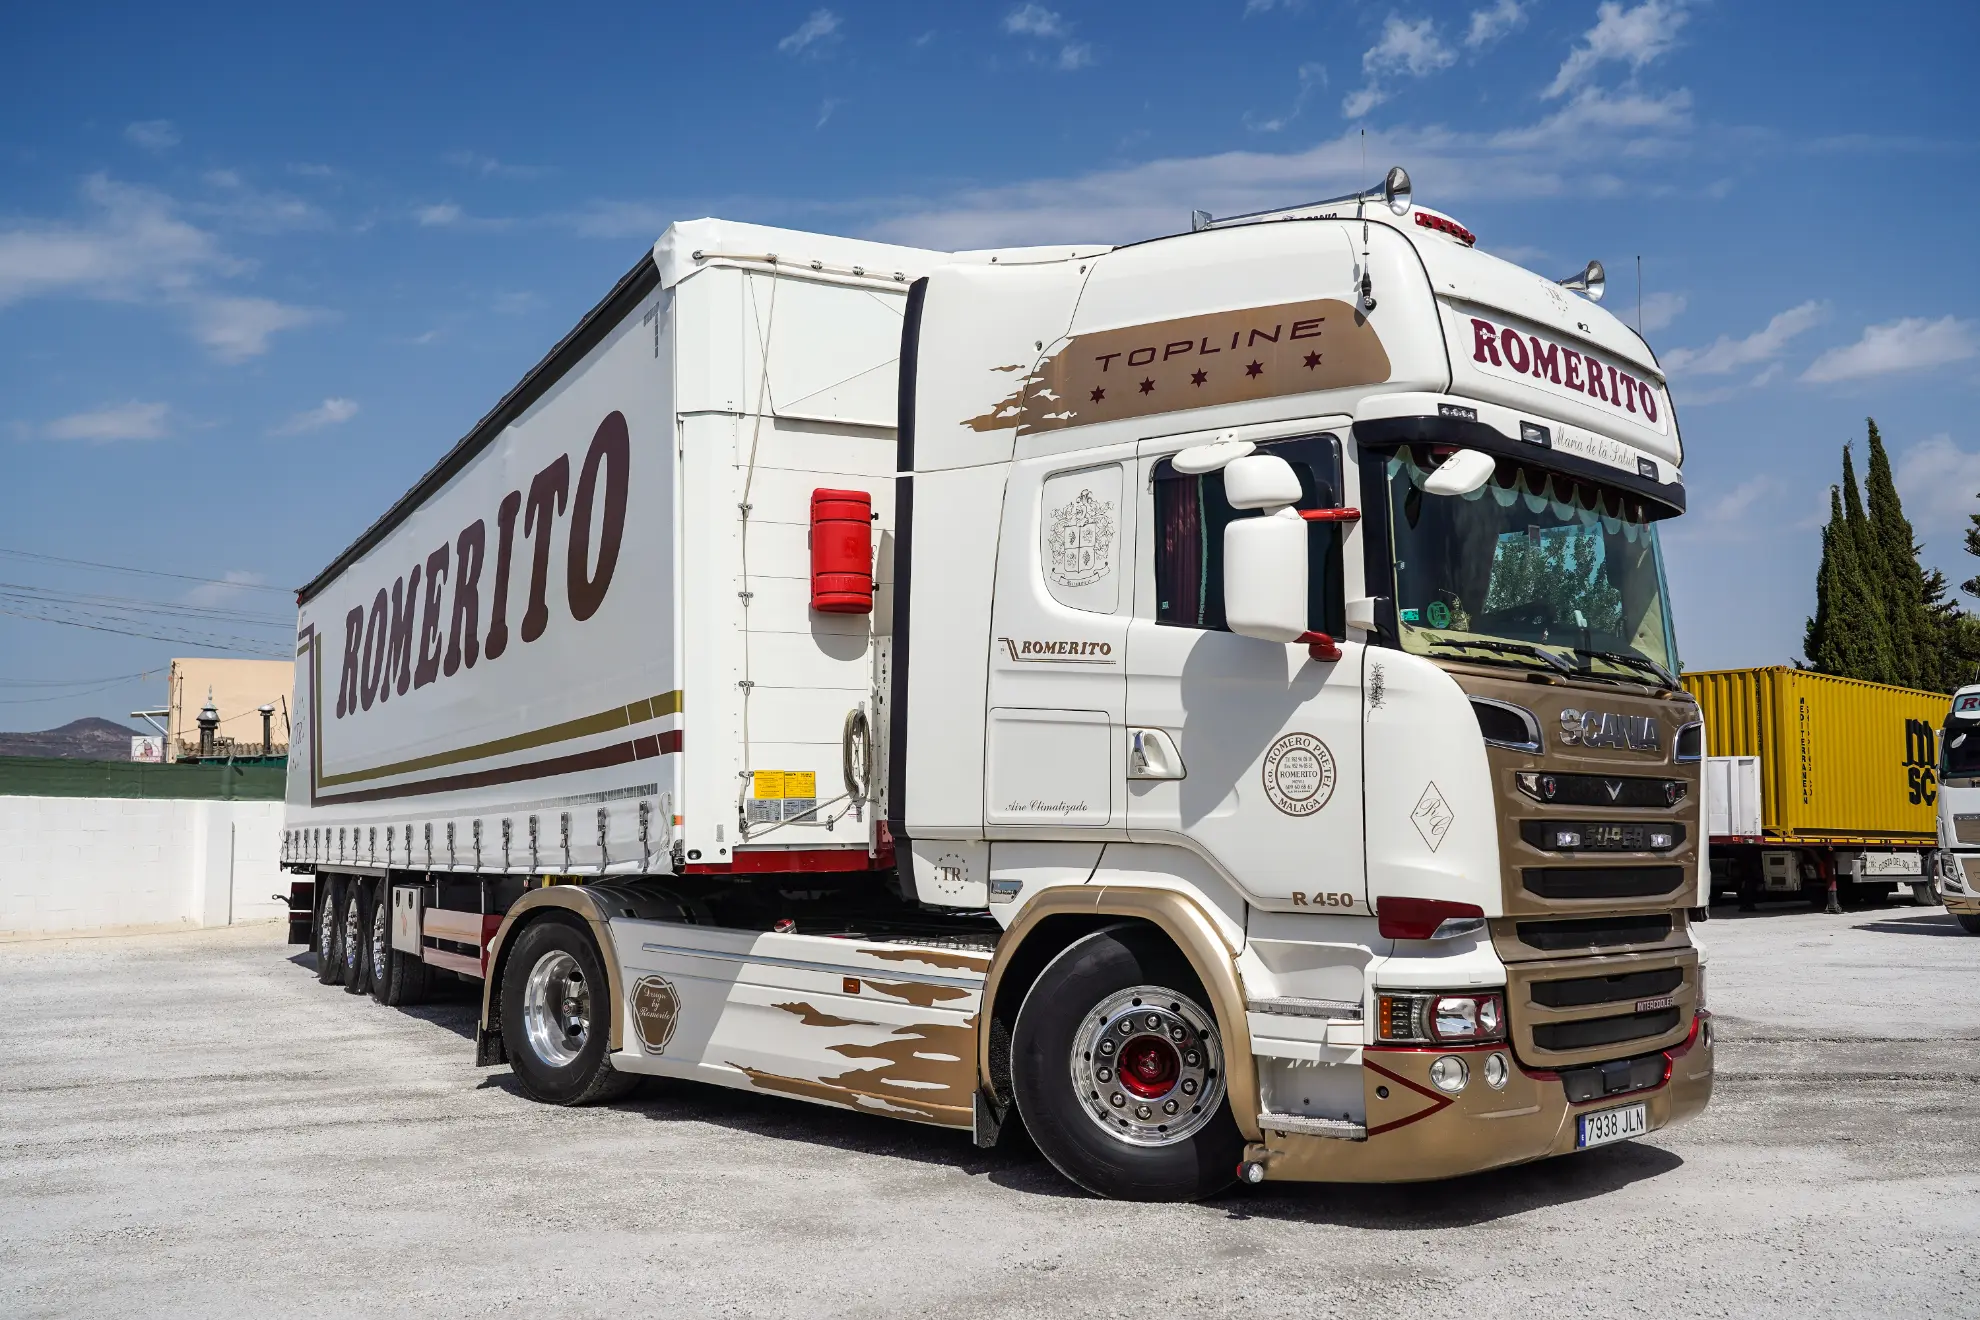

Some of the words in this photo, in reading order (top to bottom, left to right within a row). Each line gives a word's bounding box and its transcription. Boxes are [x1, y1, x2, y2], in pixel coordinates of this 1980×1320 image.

[1095, 317, 1326, 373] TOPLINE
[1470, 319, 1657, 423] ROMERITO
[1587, 437, 1596, 456] de
[1599, 440, 1608, 460] la
[1609, 441, 1636, 468] Salud
[336, 410, 630, 719] ROMERITO
[1021, 640, 1112, 656] ROMERITO
[1961, 698, 1980, 710] R
[1560, 708, 1661, 752] SCANIA
[1800, 697, 1808, 805] MEDITERRANEAN
[1268, 737, 1310, 764] ROMERO
[1313, 744, 1332, 789] PRETEL
[1005, 800, 1027, 811] Aire
[1029, 800, 1088, 816] Climatizado
[1278, 797, 1321, 812] MALAGA
[1584, 827, 1644, 849] SUPER
[940, 866, 961, 881] TR
[1292, 891, 1308, 906] R
[1313, 892, 1354, 908] 450
[644, 987, 666, 1003] Design
[639, 1006, 671, 1020] Romerito
[651, 999, 660, 1011] by
[1637, 997, 1673, 1012] INTERCOOLER
[1588, 1114, 1618, 1142] 7938
[1622, 1108, 1644, 1133] JLN
